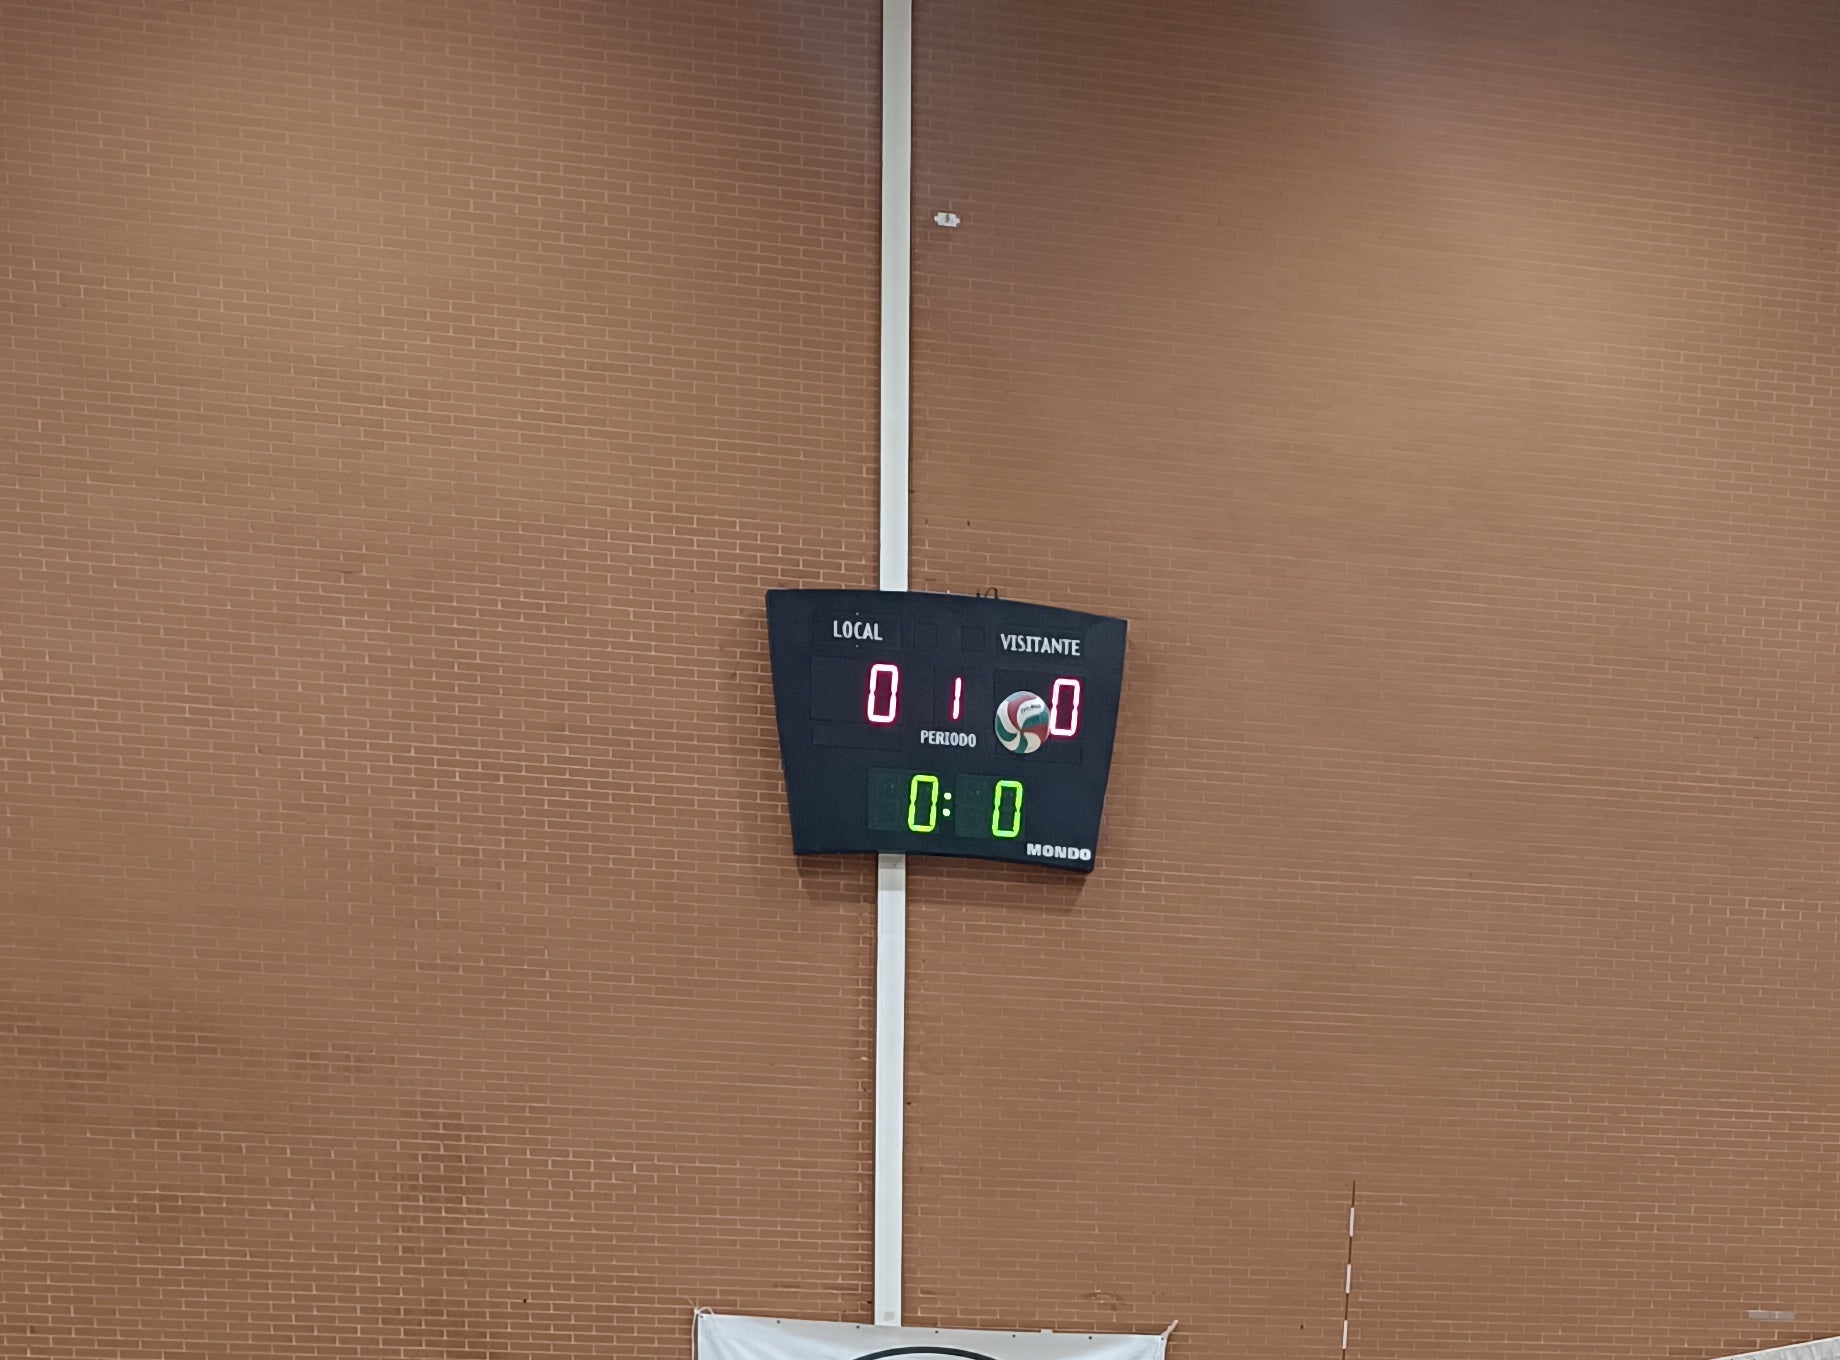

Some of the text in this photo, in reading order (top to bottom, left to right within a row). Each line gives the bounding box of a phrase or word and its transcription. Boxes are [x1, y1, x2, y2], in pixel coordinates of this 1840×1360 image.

[833, 619, 883, 641] LOCAL
[1000, 633, 1081, 656] VISITANTE
[867, 663, 899, 723] 0
[952, 677, 962, 720] 1
[1050, 678, 1080, 736] 0
[920, 730, 977, 748] PERIODO
[1026, 843, 1092, 861] MONDO
